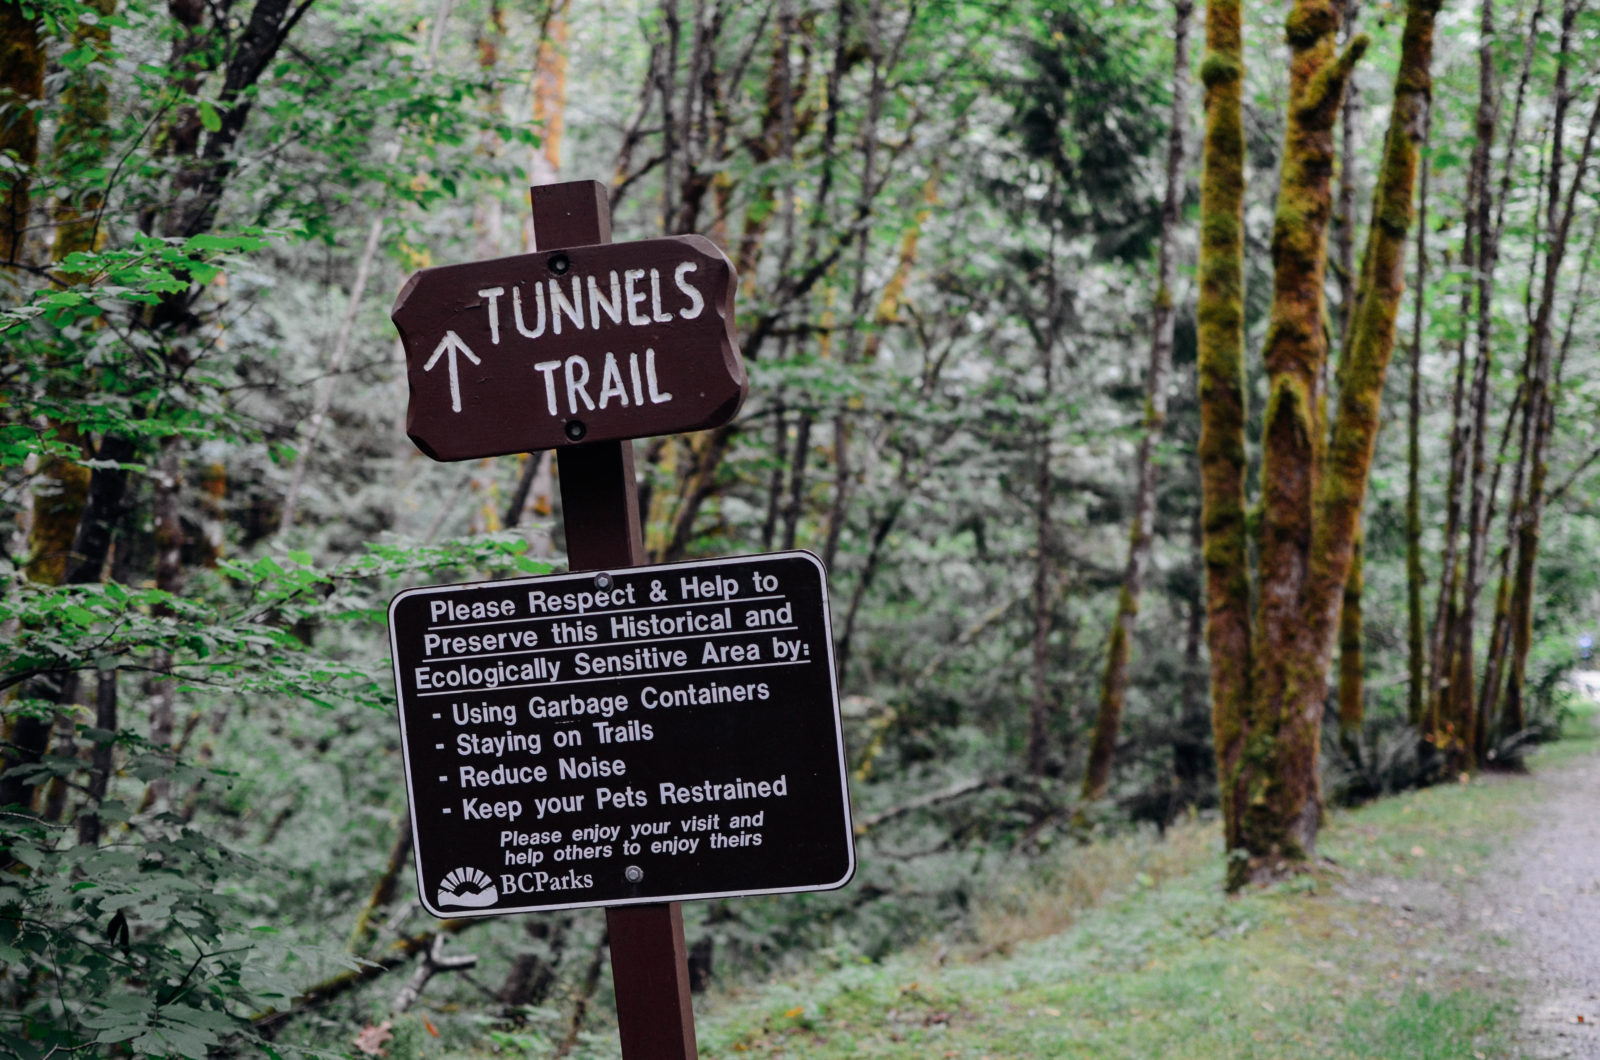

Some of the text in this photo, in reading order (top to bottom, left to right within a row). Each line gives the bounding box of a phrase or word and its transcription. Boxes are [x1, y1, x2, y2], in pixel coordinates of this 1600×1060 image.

[478, 262, 704, 344] TUNNELS
[534, 349, 672, 416] TRAIL
[431, 572, 778, 622] Please Respect & Help to
[424, 602, 792, 655] Preserve this Historical and
[415, 637, 810, 690] Ecologically Sensitive Area by:
[453, 702, 516, 725] Using
[529, 695, 629, 719] Garbage
[641, 683, 769, 709] Containers
[457, 731, 541, 757] Staying
[554, 730, 581, 747] on
[593, 720, 653, 743] Trails
[460, 764, 547, 787] Reduce
[559, 757, 625, 779] Noise
[463, 798, 522, 821] Keep
[535, 795, 584, 819] your
[597, 787, 647, 809] Pets
[660, 775, 787, 804] Restrained
[501, 811, 763, 847] Please enjoy your visit and
[505, 831, 762, 866] help others to enjoy theirs
[500, 869, 593, 894] BCParks
